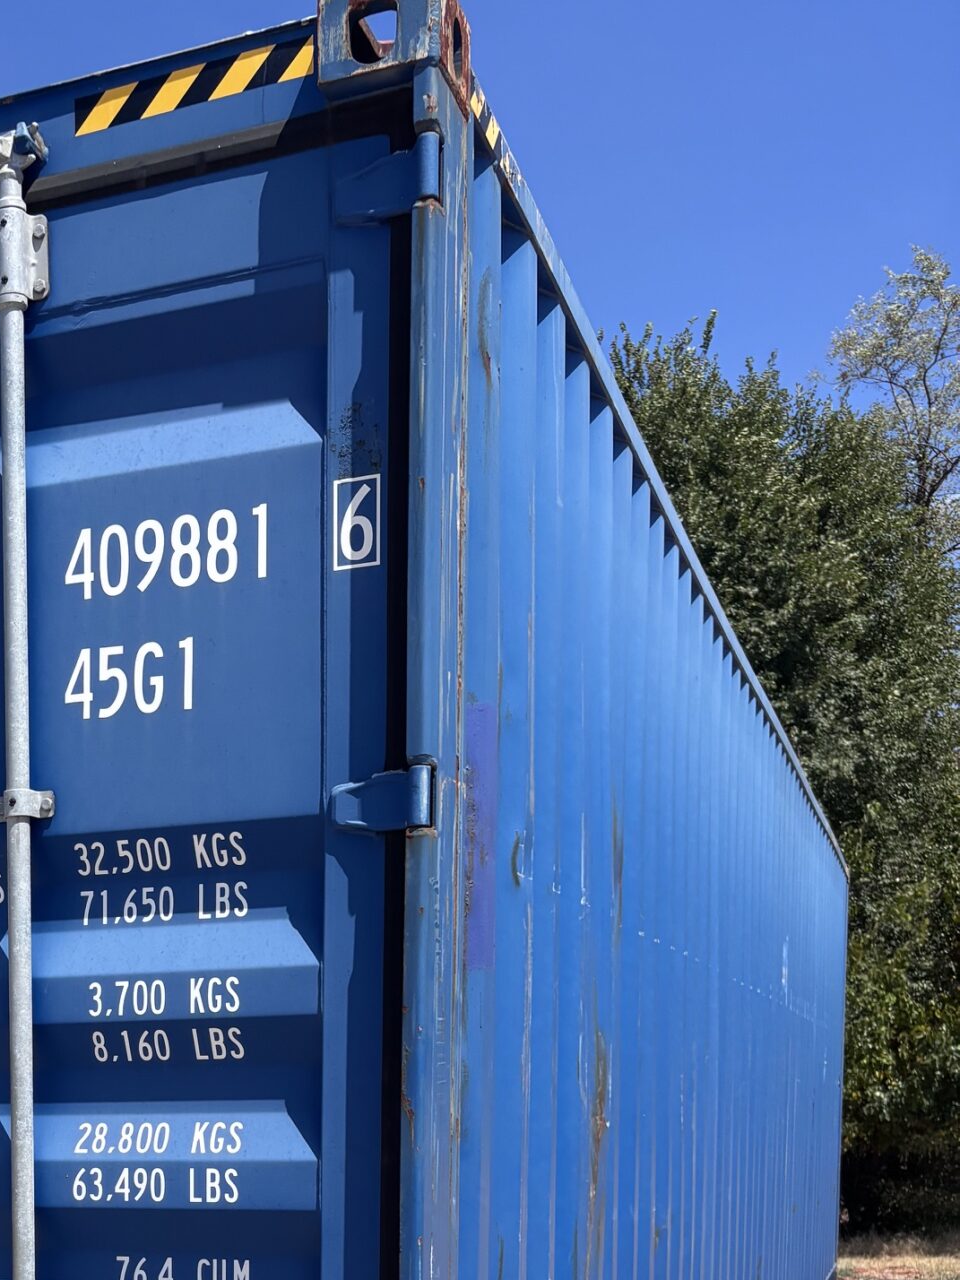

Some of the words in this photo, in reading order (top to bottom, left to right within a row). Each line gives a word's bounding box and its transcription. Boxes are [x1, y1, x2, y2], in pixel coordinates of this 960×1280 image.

[65, 503, 268, 600] 409881
[340, 483, 373, 561] 6
[65, 637, 194, 719] 45G1
[74, 837, 171, 876] 32,500
[193, 831, 247, 869] KGS
[81, 886, 174, 926] 71,650
[199, 881, 248, 920] LBS
[89, 980, 166, 1017] 3,700
[190, 976, 240, 1014] KGS
[93, 1029, 171, 1062] 8,160
[192, 1027, 245, 1060] LBS
[74, 1122, 170, 1154] 28,800
[191, 1121, 244, 1154] KGS
[73, 1167, 166, 1202] 63,490
[190, 1167, 239, 1203] LBS
